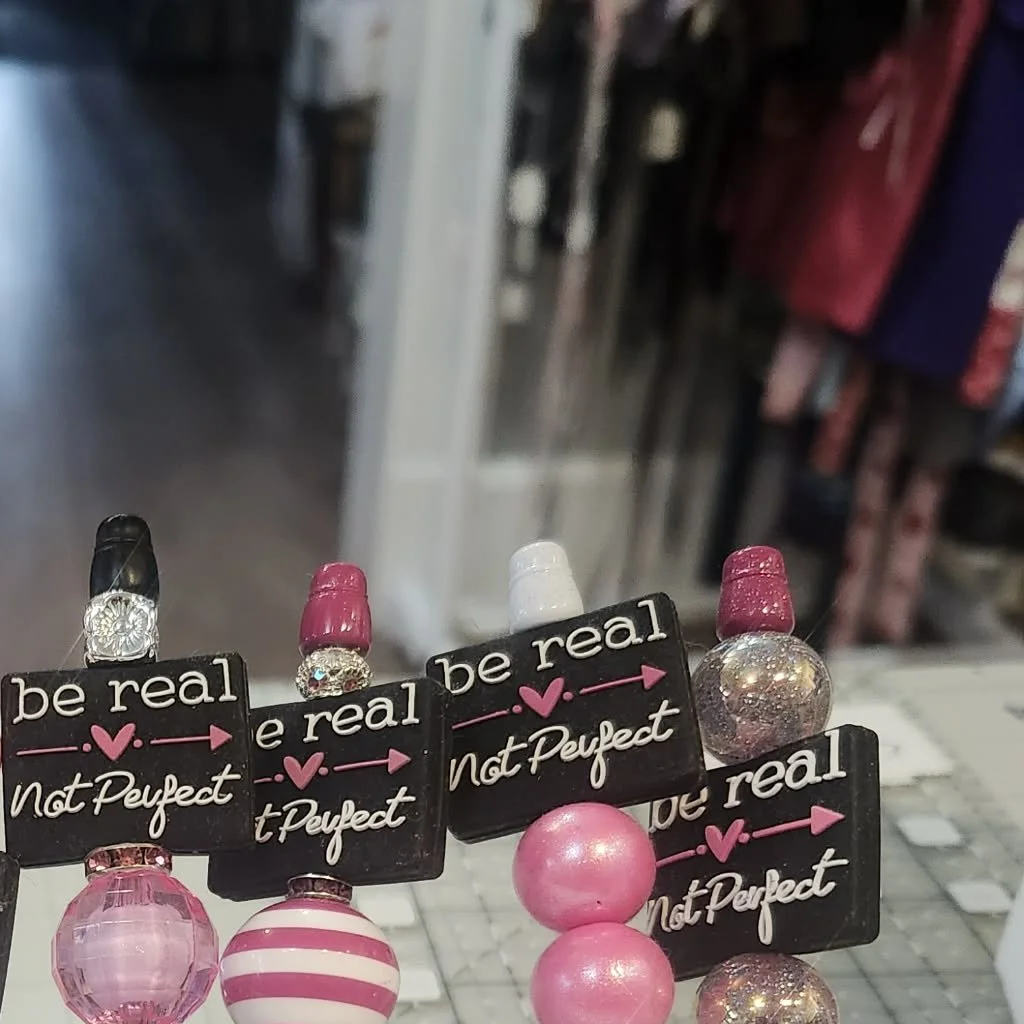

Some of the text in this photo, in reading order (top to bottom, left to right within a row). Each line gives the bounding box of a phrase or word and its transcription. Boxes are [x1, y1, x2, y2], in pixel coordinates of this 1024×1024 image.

[435, 599, 667, 695] be real
[11, 659, 237, 724] be real
[250, 683, 420, 750] e real
[448, 699, 680, 791] Not Perfect
[723, 729, 847, 809] real
[10, 775, 93, 819] Not
[94, 764, 242, 840] Perfect
[279, 786, 416, 865] Perfect
[706, 847, 849, 946] Perfect
